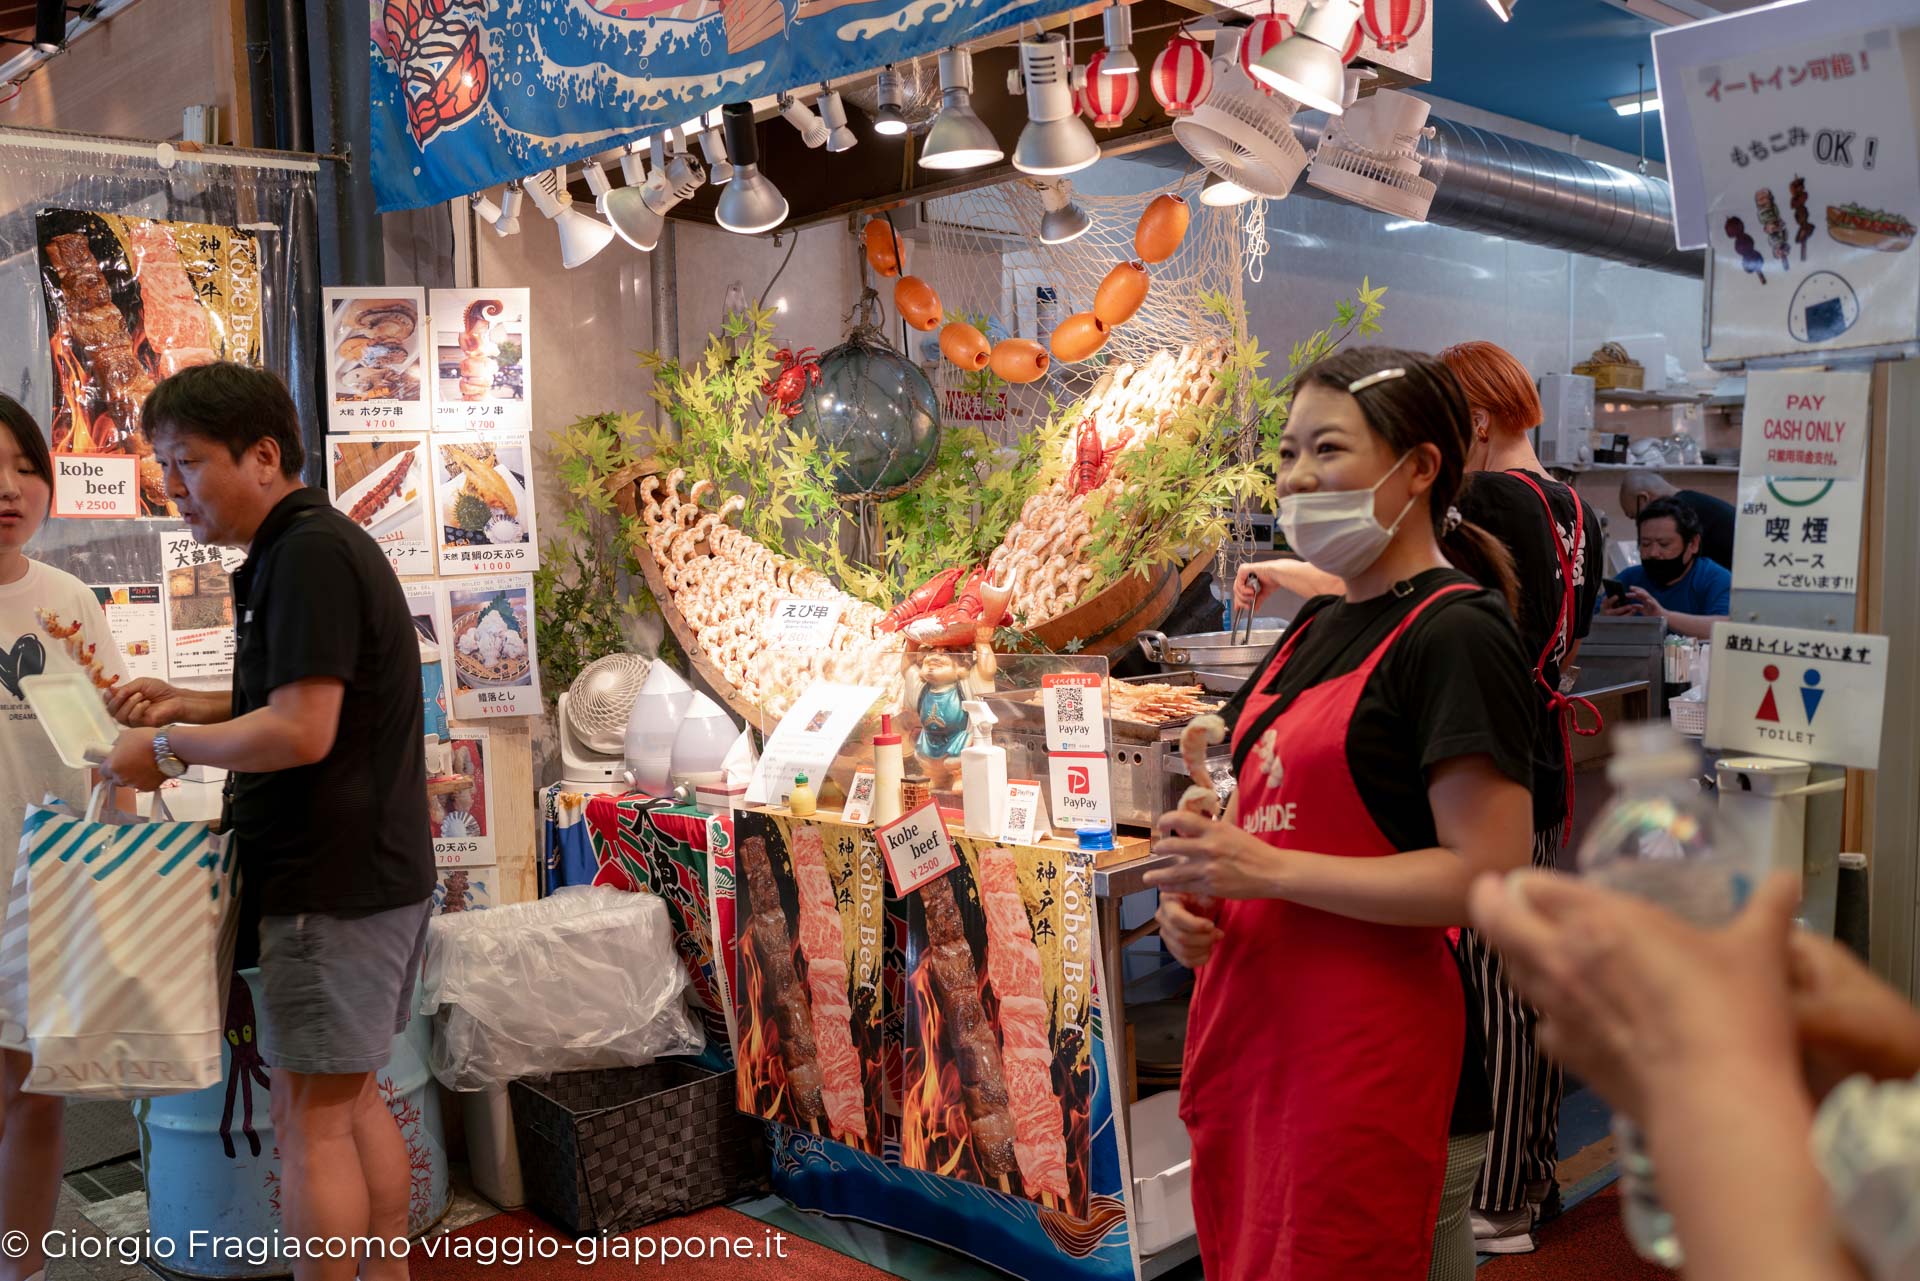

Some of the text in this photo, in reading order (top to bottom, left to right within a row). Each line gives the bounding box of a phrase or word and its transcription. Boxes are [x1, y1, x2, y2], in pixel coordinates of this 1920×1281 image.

[1705, 51, 1870, 102] イートイン可能！
[1731, 126, 1809, 168] もちこみ
[199, 235, 222, 303] 神戸牛
[229, 236, 254, 365] Kobe Bee
[1786, 394, 1826, 411] PAY
[360, 406, 403, 417] ホタテ串
[366, 420, 396, 428] ¥700
[470, 420, 496, 429] ¥700
[1763, 418, 1846, 443] CASH ONLY
[60, 461, 104, 477] kobe
[85, 479, 126, 495] beef
[75, 500, 117, 511] ¥2500
[1742, 502, 1768, 515] 店内
[1765, 516, 1829, 544] 喫煙
[174, 546, 222, 567] 大募集
[384, 547, 429, 557] インナー
[461, 549, 525, 561] 真鯛の天ぷら
[1763, 552, 1825, 569] スペース
[474, 562, 511, 571] ¥1000
[782, 604, 829, 618] えび串
[1725, 634, 1871, 663] 店内トイレございます
[9, 713, 38, 721] DREAMS
[482, 704, 515, 715] ¥1000
[1058, 724, 1091, 736] PayPay
[1756, 726, 1817, 745] TOILET
[1063, 796, 1098, 811] PayPay
[886, 824, 920, 851] kobe
[910, 830, 940, 861] beef
[434, 841, 479, 853] の天ぷら
[439, 855, 462, 864] 700
[838, 837, 855, 913] 神戸牛
[909, 856, 940, 881] ¥2500
[1036, 860, 1057, 945] 神戸牛
[859, 841, 879, 1000] Kobe Beef
[1062, 863, 1088, 1043] Kobe Beef
